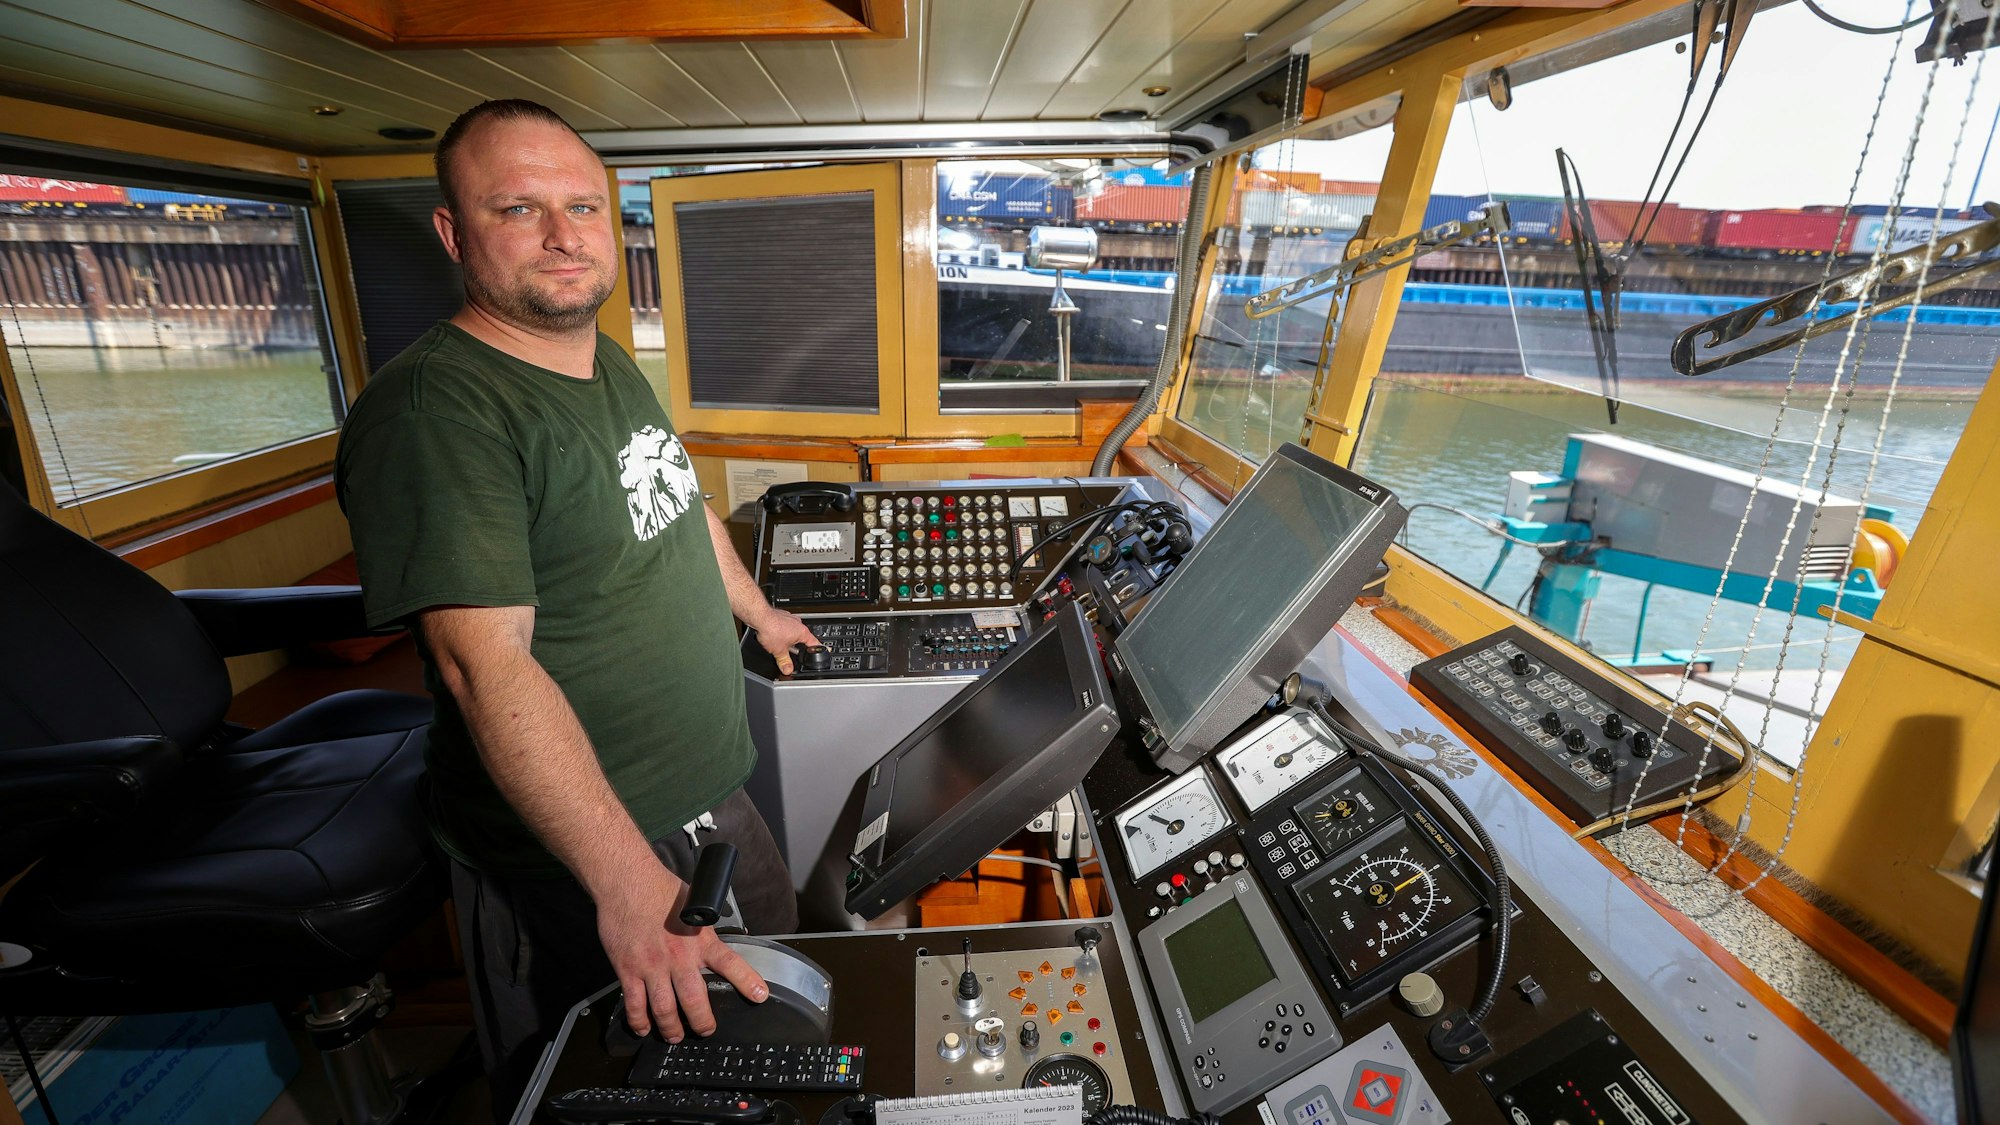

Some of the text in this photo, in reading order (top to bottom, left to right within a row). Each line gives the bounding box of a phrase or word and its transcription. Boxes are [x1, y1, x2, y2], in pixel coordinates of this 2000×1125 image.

[940, 266, 968, 279] ION
[1236, 879, 1247, 891] JRC
[1398, 910, 1409, 923] 200
[1179, 1018, 1193, 1045] COMPASS
[1633, 1070, 1678, 1119] CLINOMETER
[1057, 1104, 1075, 1112] 2023
